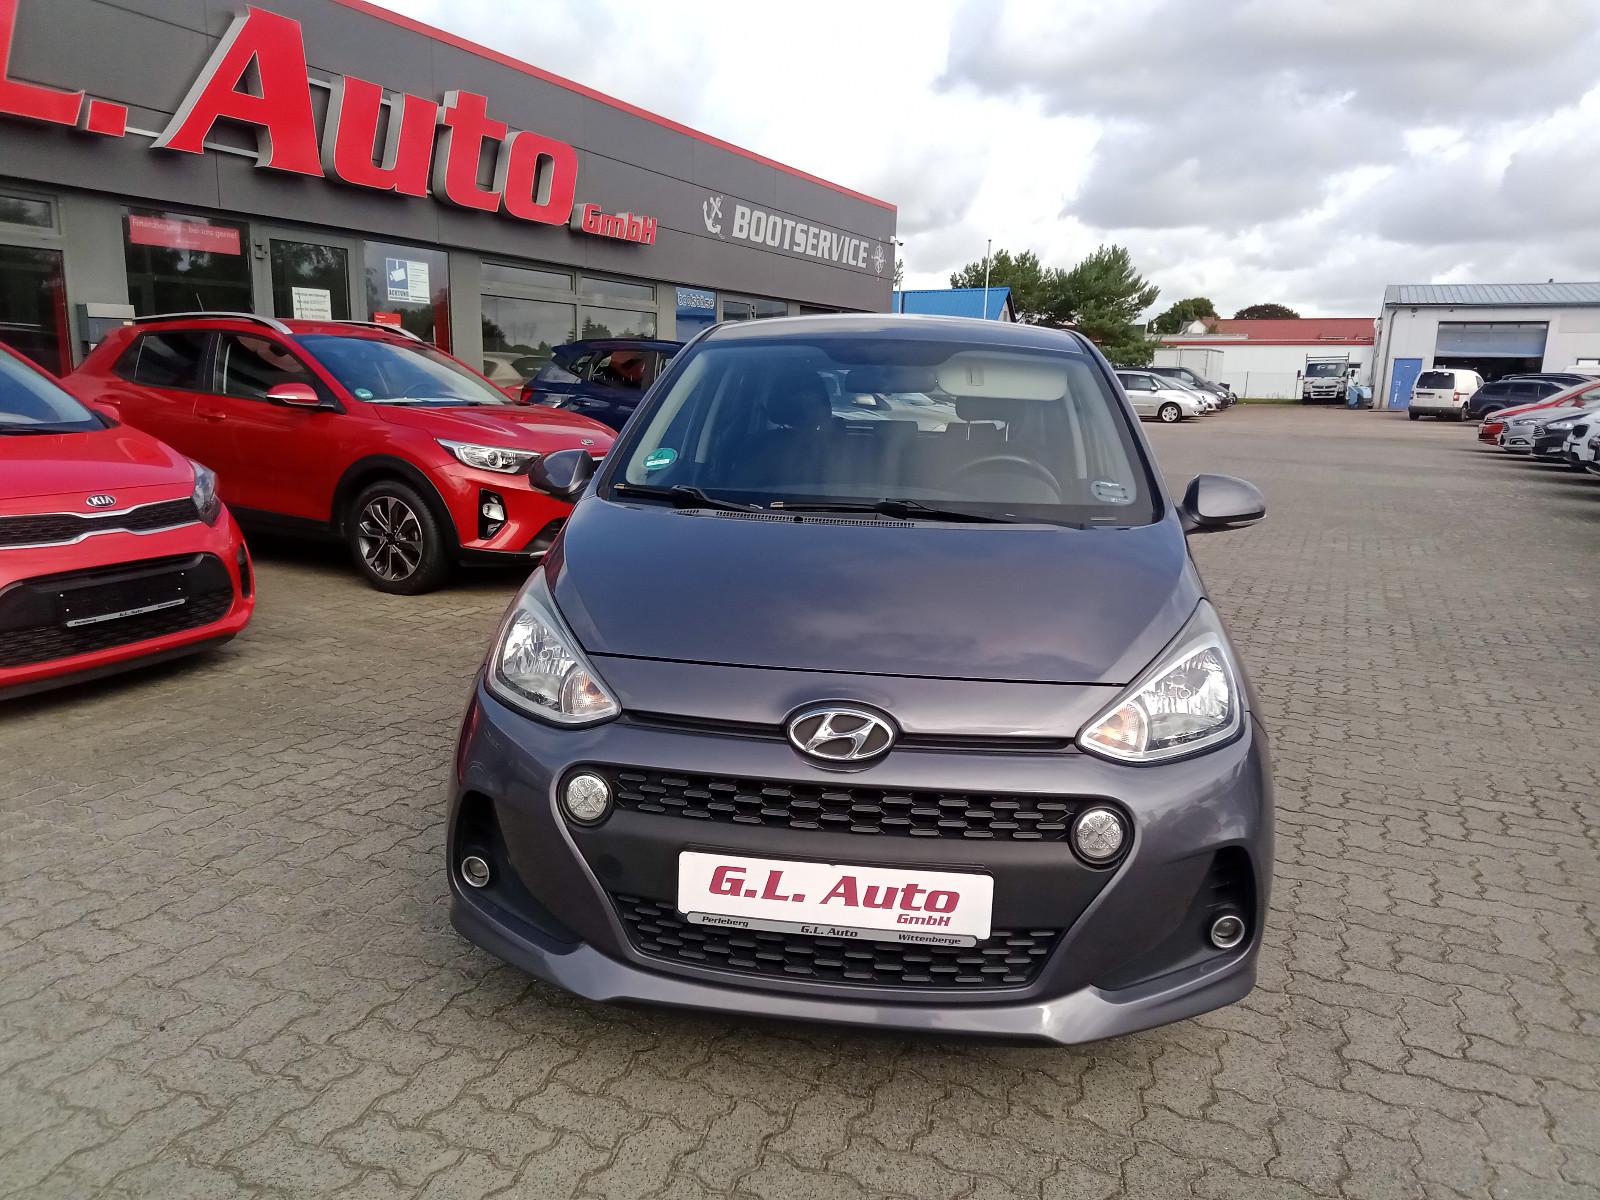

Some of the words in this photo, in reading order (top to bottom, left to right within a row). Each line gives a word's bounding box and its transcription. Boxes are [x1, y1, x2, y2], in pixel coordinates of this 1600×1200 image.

[154, 5, 578, 226] Auto
[578, 202, 658, 245] GmbH
[731, 204, 870, 269] BOOTSERVICE
[90, 495, 114, 505] KIA
[708, 865, 806, 903] G.L.
[819, 875, 961, 914] Auto
[702, 915, 749, 928] Perleberg
[800, 925, 824, 936] G.L.
[827, 927, 859, 938] Auto
[898, 933, 962, 946] Wittenberge
[896, 913, 952, 928] GmbH
